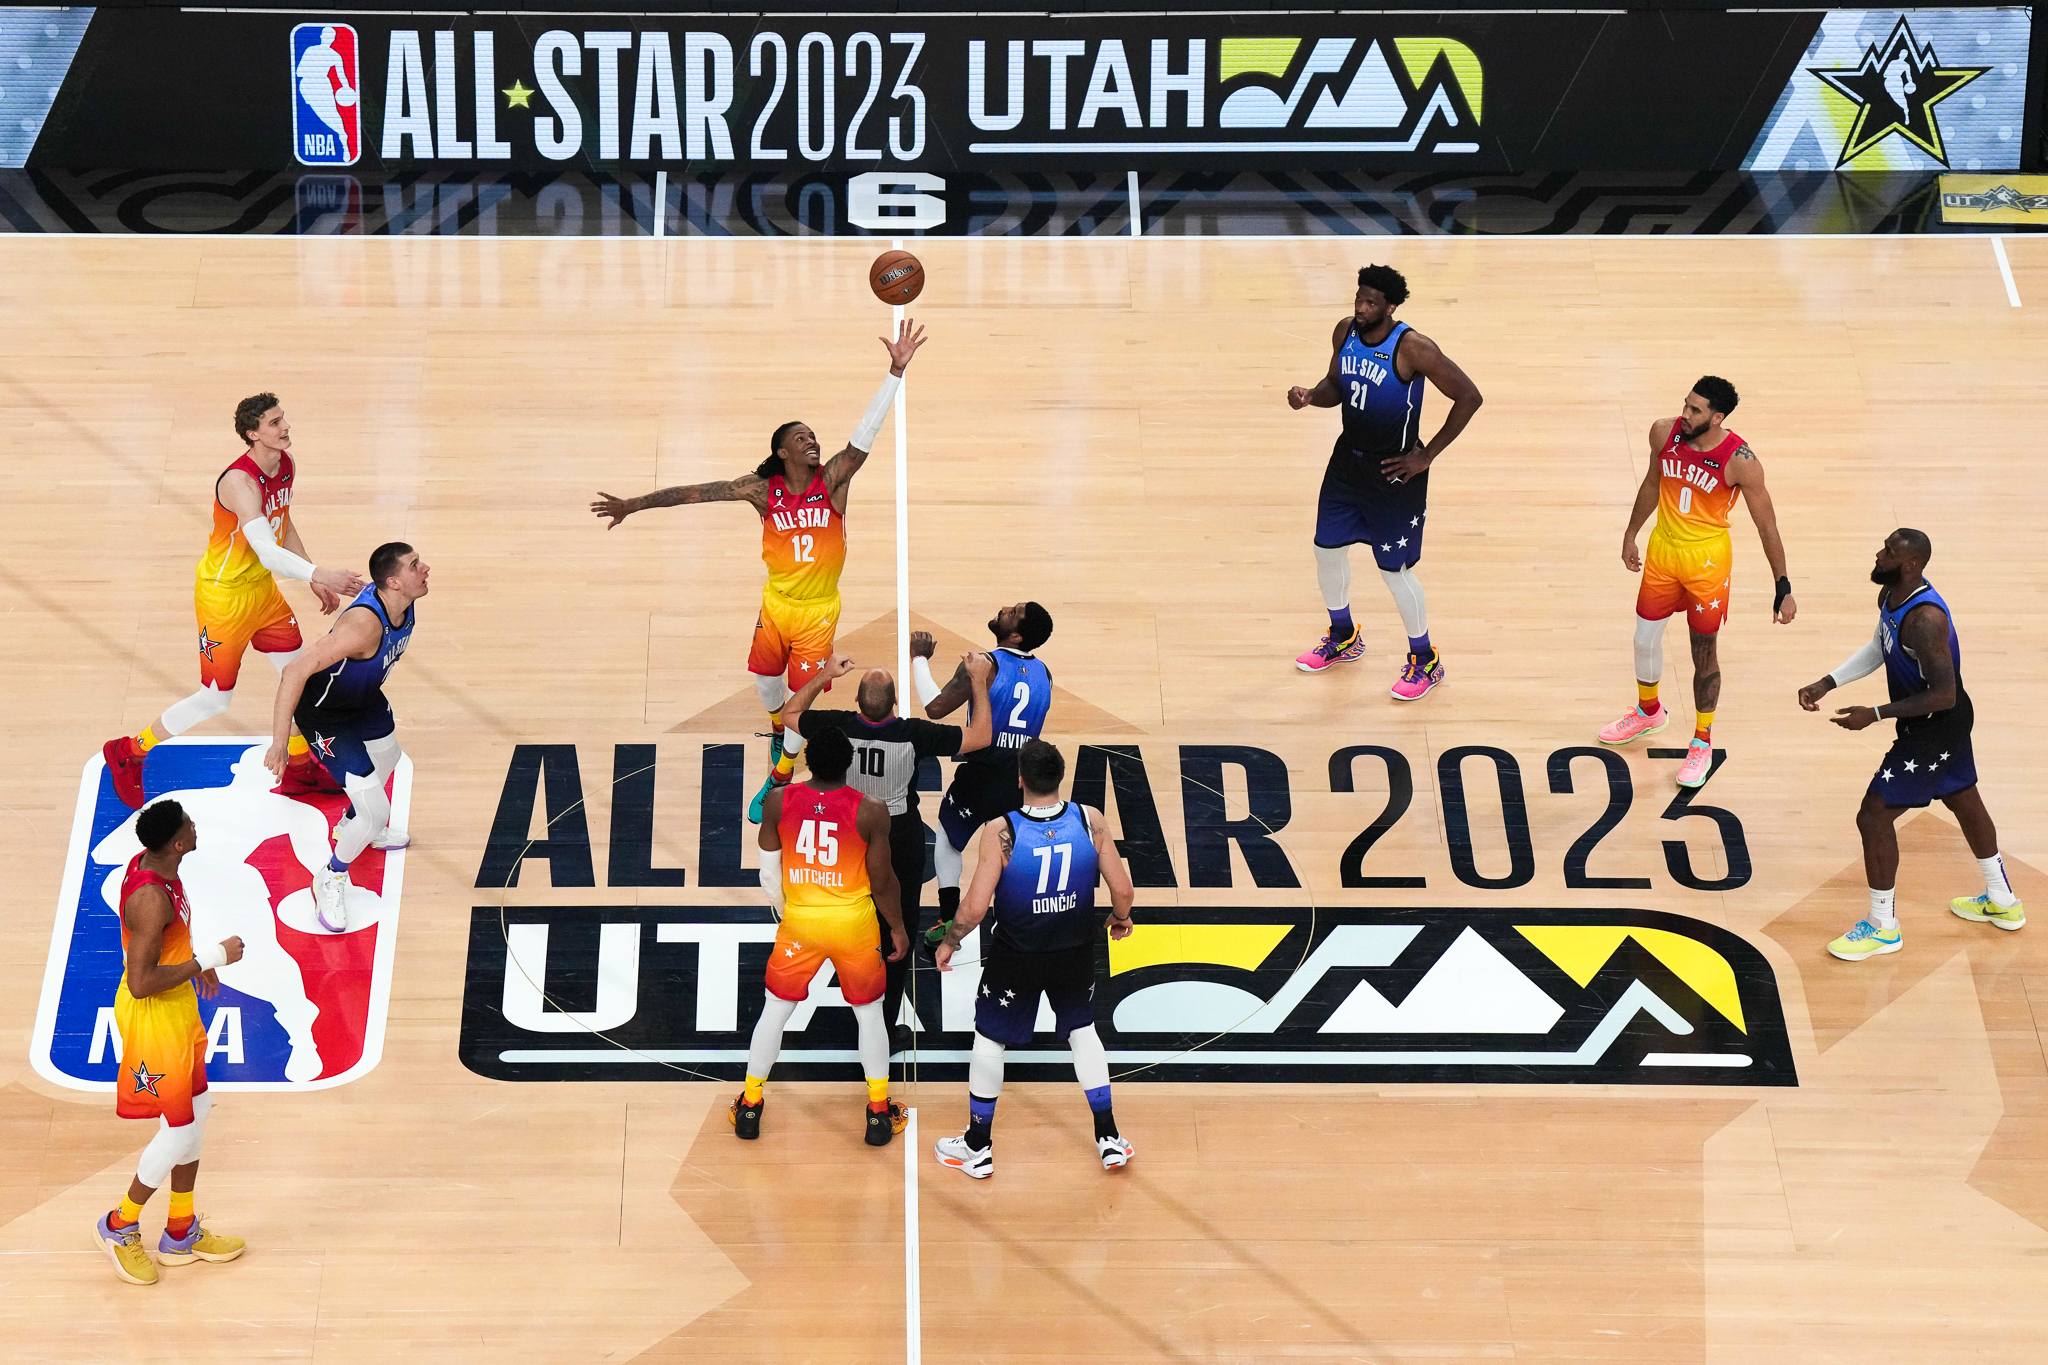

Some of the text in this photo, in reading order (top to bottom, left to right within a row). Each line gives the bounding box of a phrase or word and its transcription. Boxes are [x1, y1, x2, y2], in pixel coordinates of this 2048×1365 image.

[750, 31, 926, 161] 2023
[968, 39, 1206, 132] UTAH
[304, 134, 336, 156] NBA
[848, 172, 946, 229] 6
[1946, 196, 1974, 206] UT
[879, 265, 914, 285] Wilson
[1351, 329, 1356, 338] 6
[1350, 380, 1368, 410] 21
[1674, 434, 1681, 443] 6
[260, 475, 266, 484] 6
[1662, 459, 1718, 494] ALL-STAR
[775, 488, 782, 497] 6
[1679, 487, 1693, 514] 0
[772, 507, 831, 531] ALL-STAR
[791, 534, 815, 562] 12
[1008, 681, 1030, 729] 2
[996, 732, 1033, 749] IRVIN
[858, 747, 885, 777] 10
[1328, 745, 1753, 890] 2023
[795, 819, 839, 867] 45
[789, 868, 844, 887] MITCHELL
[1032, 842, 1073, 894] 77
[1032, 891, 1077, 914] DONČIĆ
[87, 1006, 245, 1064] NA
